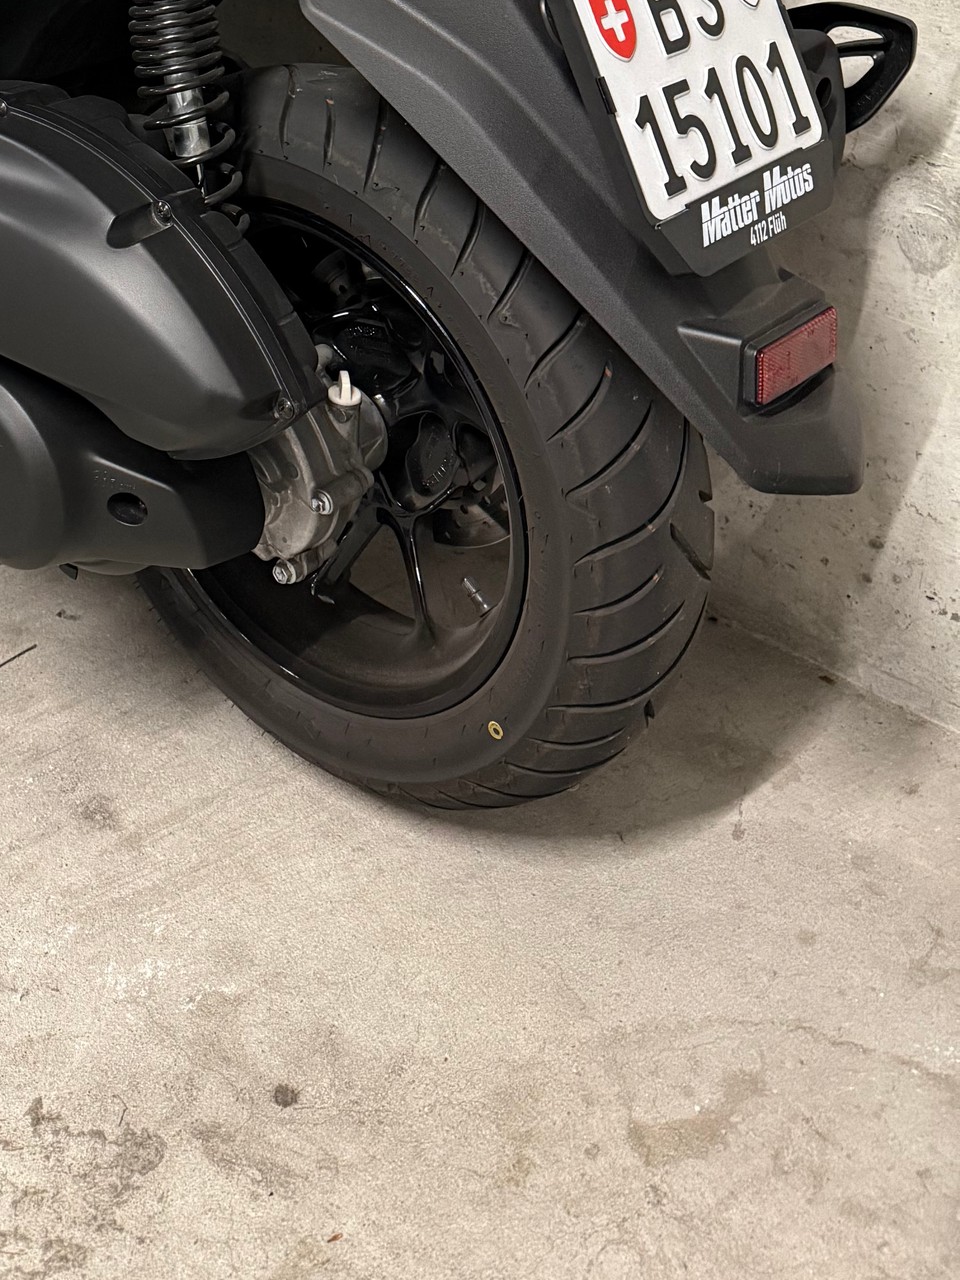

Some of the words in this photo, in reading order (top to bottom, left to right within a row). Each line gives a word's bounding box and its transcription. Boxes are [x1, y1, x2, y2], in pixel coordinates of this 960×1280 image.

[635, 41, 811, 198] 15101
[701, 190, 760, 247] Matter
[763, 163, 814, 214] Motos
[750, 220, 769, 246] 4112
[768, 211, 787, 237] Flüh
